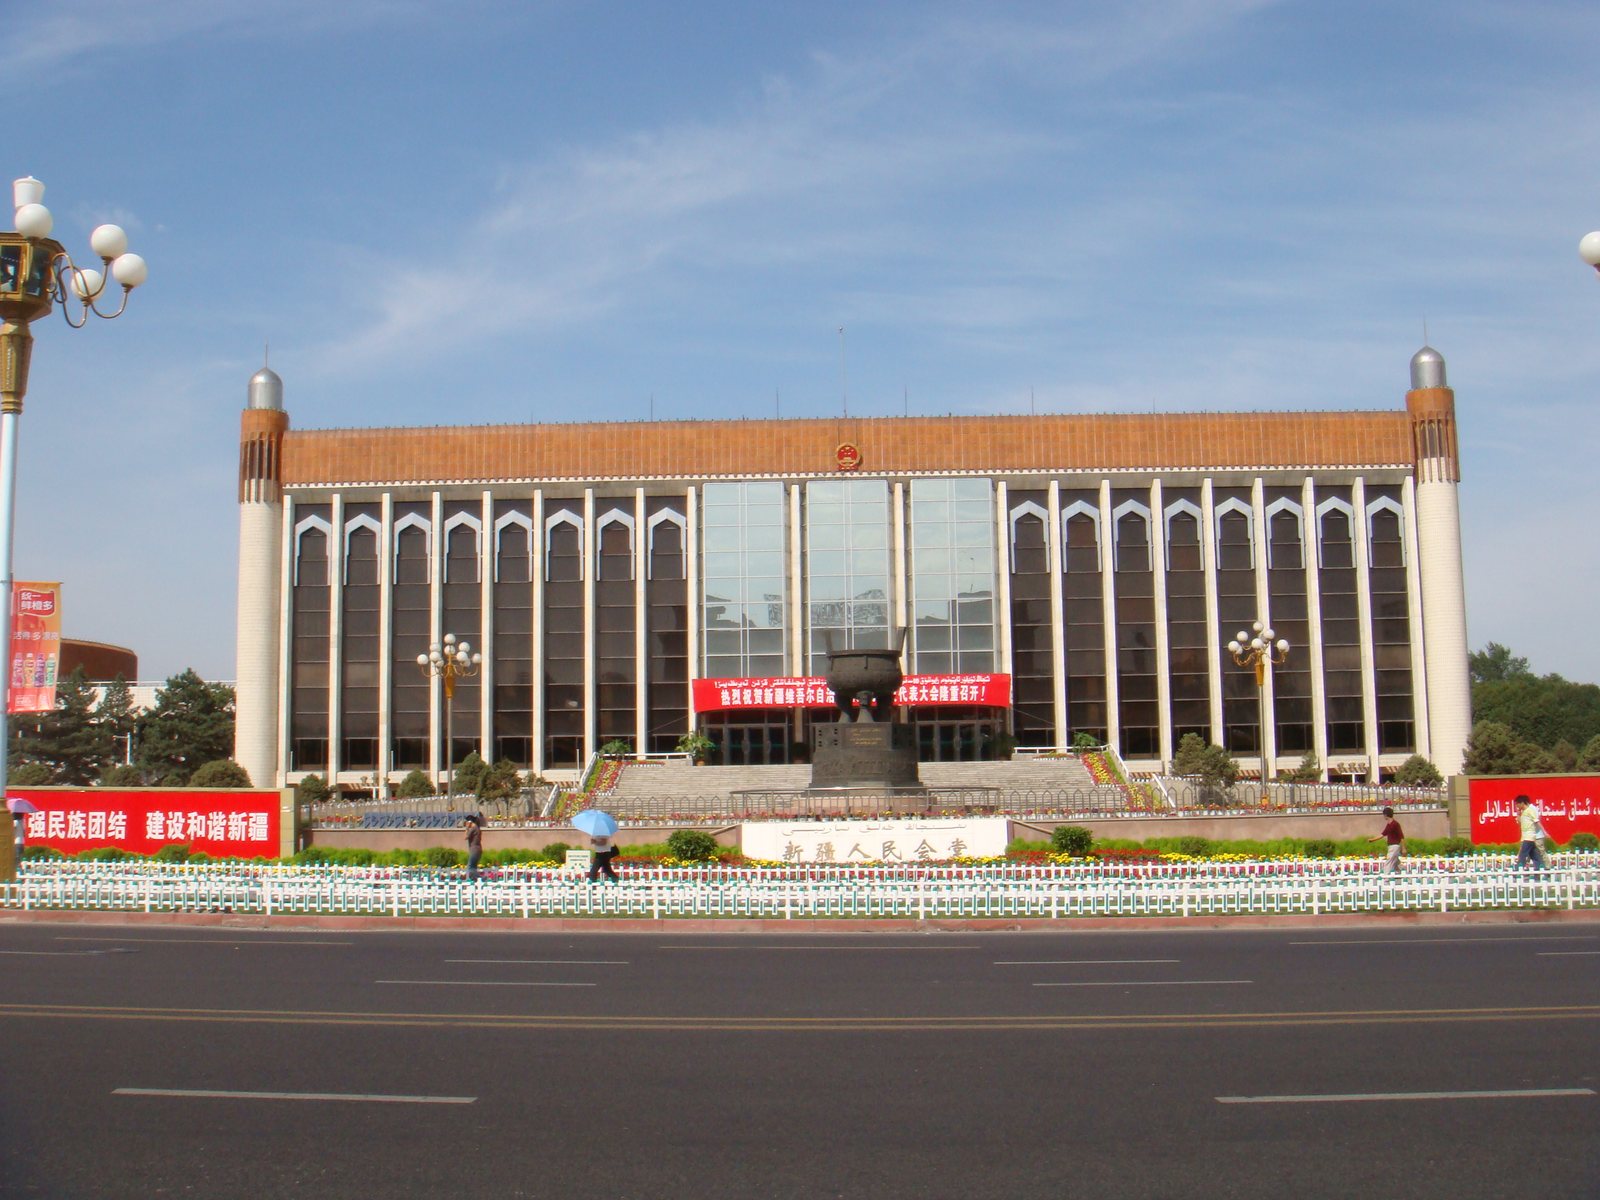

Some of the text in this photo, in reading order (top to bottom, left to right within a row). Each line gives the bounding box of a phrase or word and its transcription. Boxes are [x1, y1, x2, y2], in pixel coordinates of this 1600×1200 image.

[893, 685, 986, 702] 代表大会隆重召开!
[27, 811, 269, 842] 强民族团结 建设和谐新疆
[782, 838, 968, 863] 新疆人民会堂
